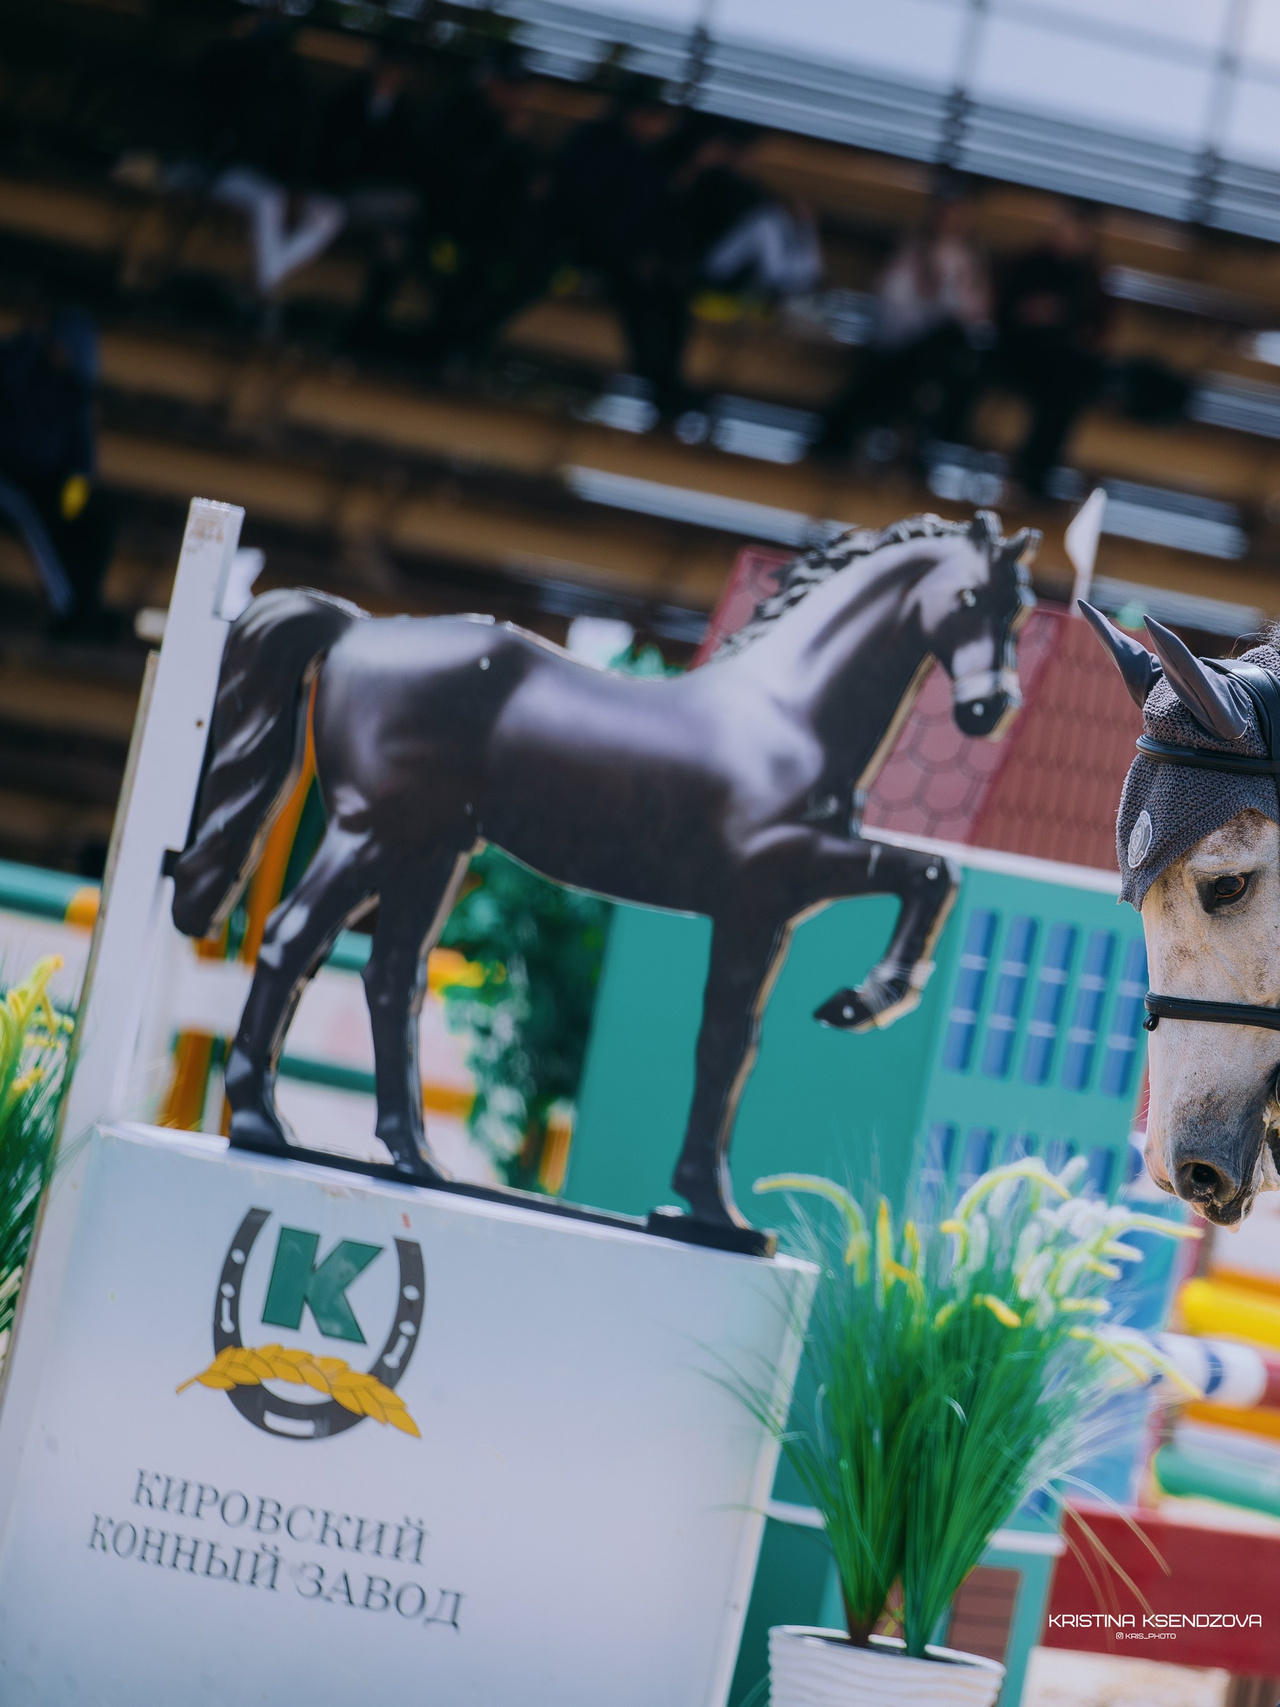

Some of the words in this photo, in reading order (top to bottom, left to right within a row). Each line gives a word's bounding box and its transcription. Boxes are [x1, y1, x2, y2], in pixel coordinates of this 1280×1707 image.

[131, 1467, 430, 1567] КИРОВСКИЙ
[86, 1513, 284, 1593] КОННЫЙ
[294, 1560, 467, 1635] ЗАВОД
